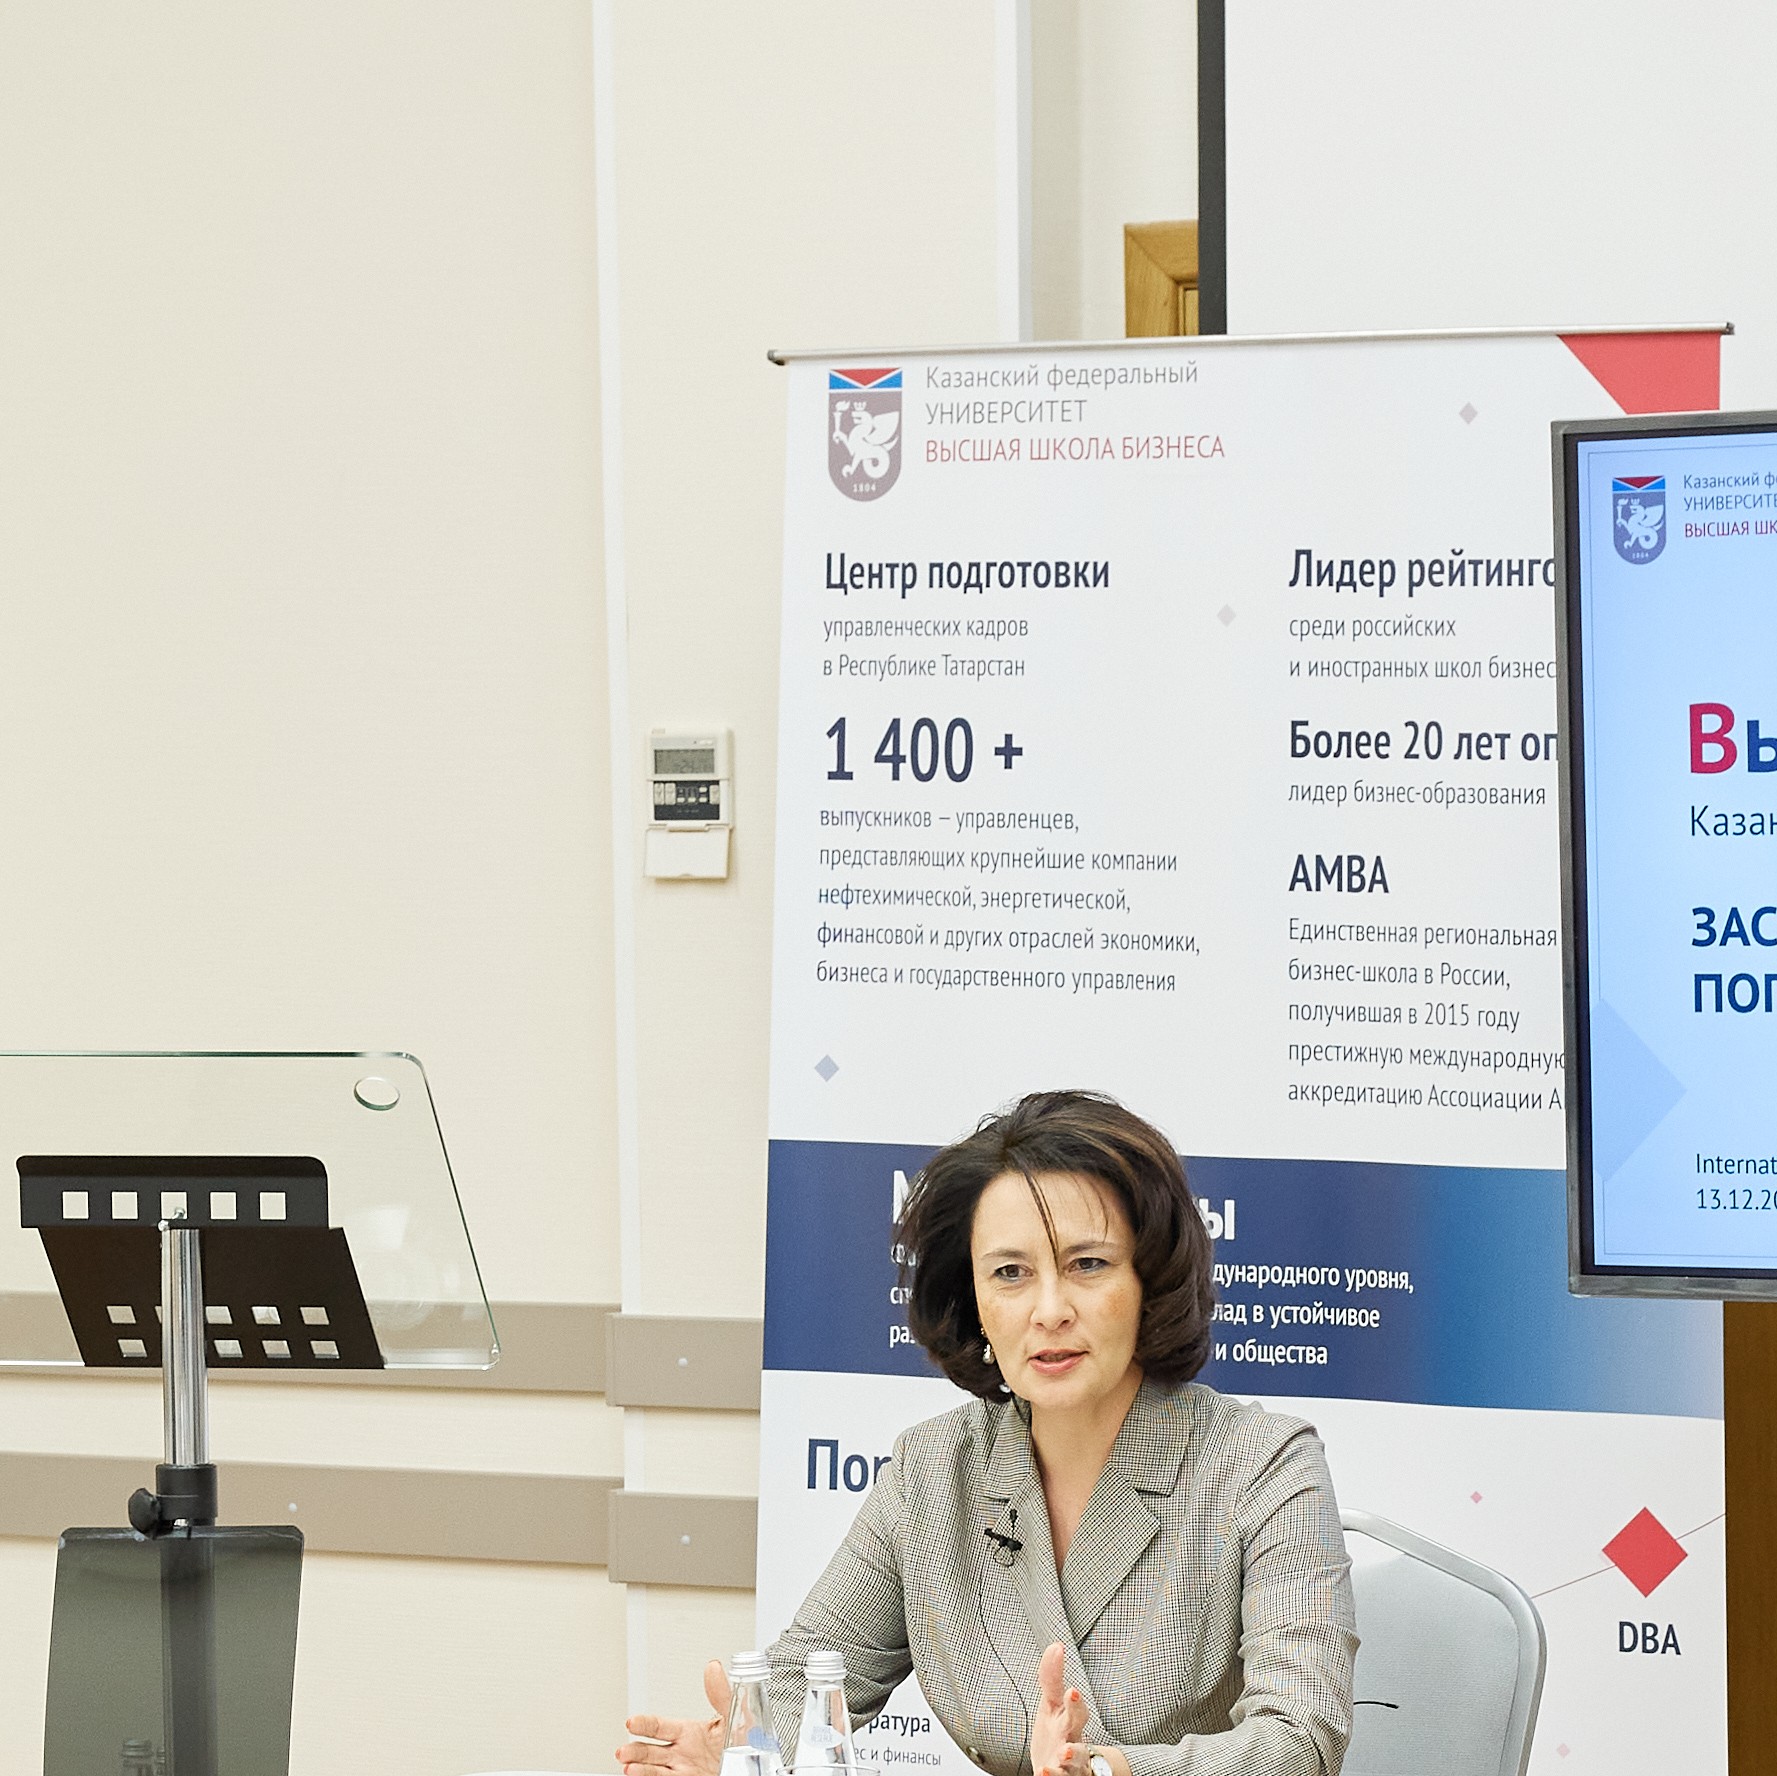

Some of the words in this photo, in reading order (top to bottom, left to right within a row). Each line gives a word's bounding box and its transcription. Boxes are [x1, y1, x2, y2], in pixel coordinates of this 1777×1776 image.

[926, 364, 1038, 389] Казанский
[1047, 360, 1198, 391] федеральный
[926, 399, 1087, 425] УНИВЕРСИТЕТ
[925, 438, 1020, 463] ВЫСШАЯ
[1029, 437, 1115, 461] ШКОЛА
[1123, 435, 1225, 460] БИЗНЕСА
[1683, 473, 1759, 489] Казанский
[1685, 521, 1750, 538] ВЫСШАЯ
[825, 552, 917, 599] Центр
[928, 558, 1110, 594] подготовки
[1289, 549, 1396, 597] Лидер
[823, 617, 961, 642] управленческих
[966, 617, 1029, 641] кадров
[1289, 618, 1345, 641] среди
[1352, 614, 1457, 642] российских
[823, 657, 833, 676] в
[838, 653, 937, 682] Республике
[942, 654, 1024, 681] Татарстан
[1290, 660, 1300, 677] и
[1308, 659, 1428, 683] иностранных
[1435, 661, 1482, 678] школ
[826, 717, 853, 780] 1
[874, 717, 973, 782] 400
[1290, 720, 1391, 759] Более
[1404, 720, 1443, 760] 20
[1453, 731, 1511, 760] лет
[1289, 784, 1347, 807] лидер
[1354, 780, 1546, 809] бизнес-образования
[820, 808, 932, 831] выпускников
[956, 810, 1079, 834] управленцев,
[819, 847, 965, 869] представляющих
[971, 848, 1085, 873] крупнейшие
[1091, 852, 1178, 872] компании
[818, 884, 977, 909] нефтехимической,
[981, 887, 1131, 913] энергетической,
[817, 922, 924, 948] финансовой
[930, 930, 939, 945] и
[944, 927, 1002, 951] других
[1009, 927, 1094, 952] отраслей
[1101, 932, 1200, 954] экономики,
[1289, 918, 1417, 943] Единственная
[1424, 926, 1557, 949] региональная
[816, 960, 888, 983] бизнеса
[894, 966, 903, 983] и
[909, 967, 1065, 991] государственного
[1072, 971, 1176, 995] управления
[1288, 958, 1417, 983] бизнес-школа
[1424, 967, 1434, 984] в
[1440, 962, 1511, 990] России,
[1289, 1003, 1402, 1027] получившая
[1409, 1007, 1417, 1024] в
[1424, 1002, 1470, 1026] 2015
[1478, 1008, 1520, 1033] году
[1289, 1043, 1403, 1069] престижную
[1288, 1083, 1423, 1107] аккредитацию
[1428, 1084, 1542, 1112] Ассоциации
[1345, 1268, 1414, 1294] уровня,
[1252, 1306, 1264, 1323] в
[1270, 1301, 1380, 1329] устойчивое
[1215, 1343, 1227, 1361] и
[1232, 1339, 1328, 1366] общества
[1619, 1621, 1681, 1655] DBA
[883, 1747, 941, 1766] финансы
